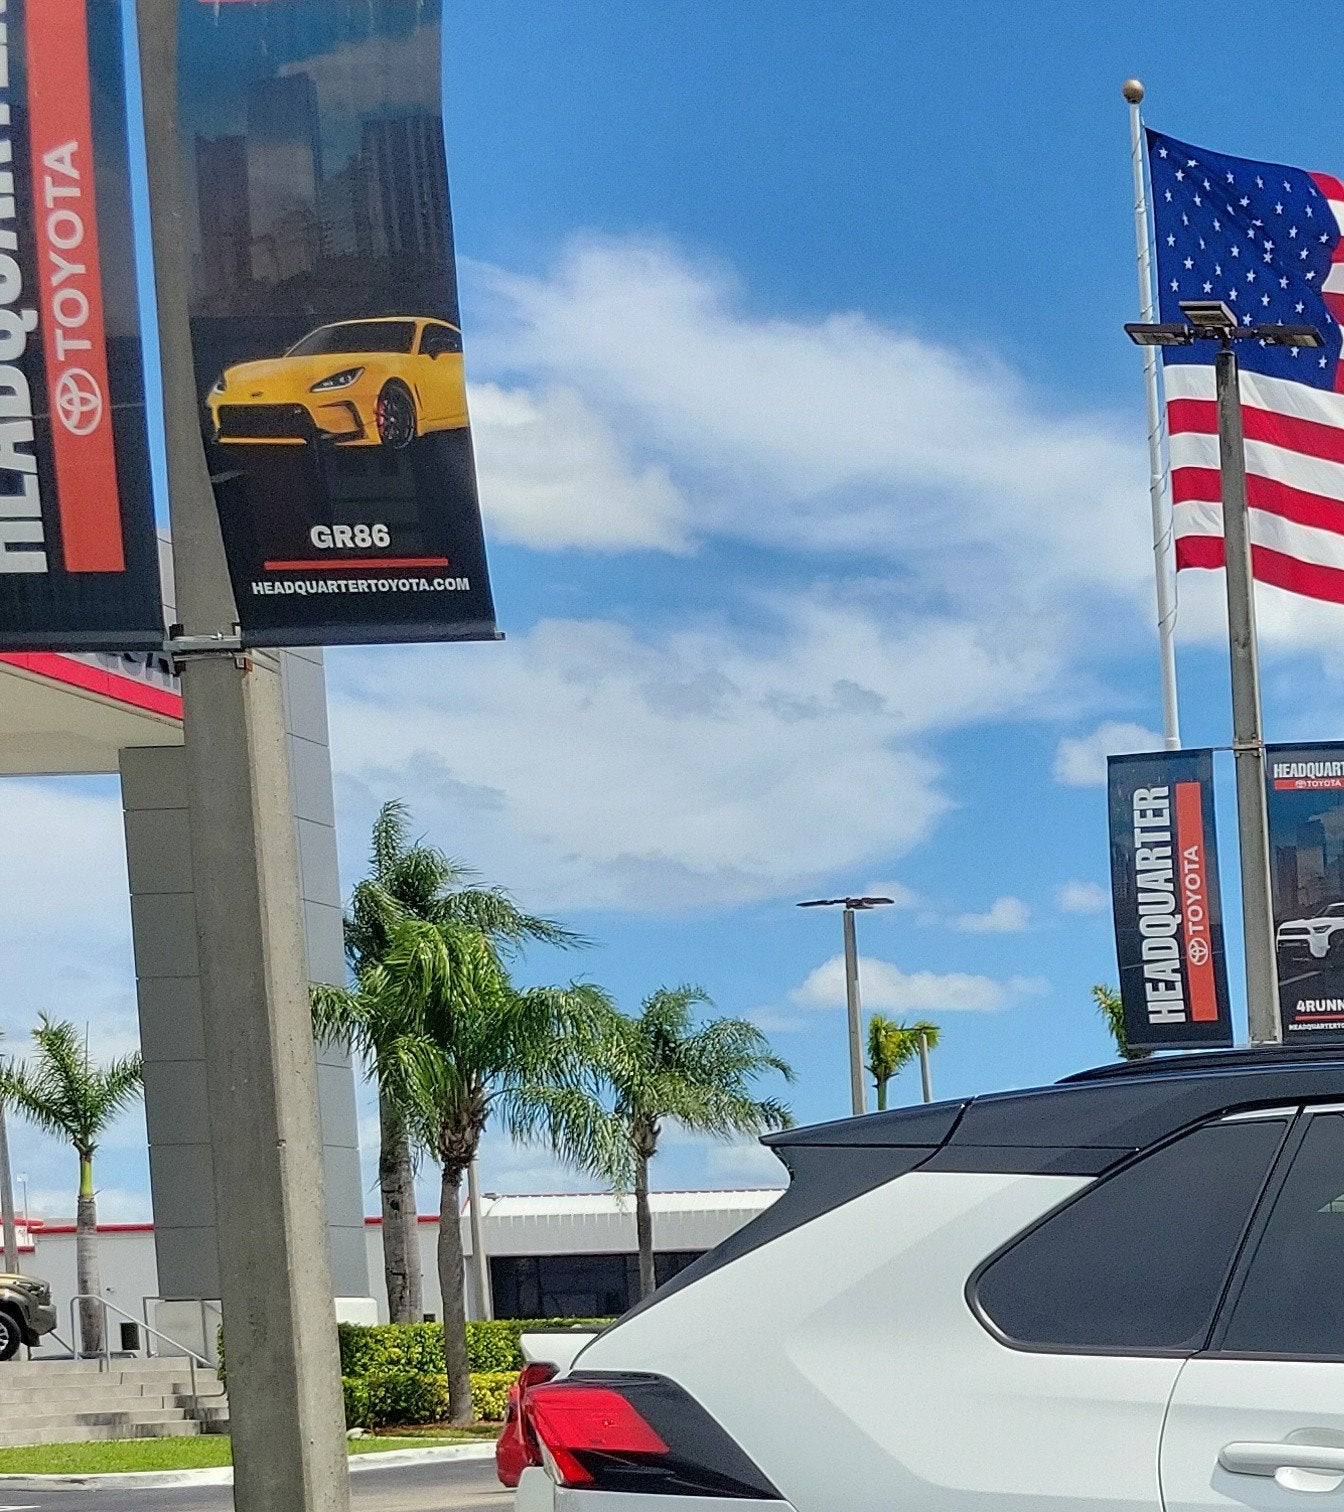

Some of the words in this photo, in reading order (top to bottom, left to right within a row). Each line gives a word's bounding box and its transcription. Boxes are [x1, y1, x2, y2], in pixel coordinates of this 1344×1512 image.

[42, 138, 92, 361] TOYOTA
[310, 523, 390, 549] GR86
[251, 577, 470, 595] HEADQUARTERTOYOTA.COM
[1307, 779, 1342, 787] TOYOTA
[1133, 785, 1187, 1024] HEADQUARTER
[1183, 845, 1205, 935] TOYOTA
